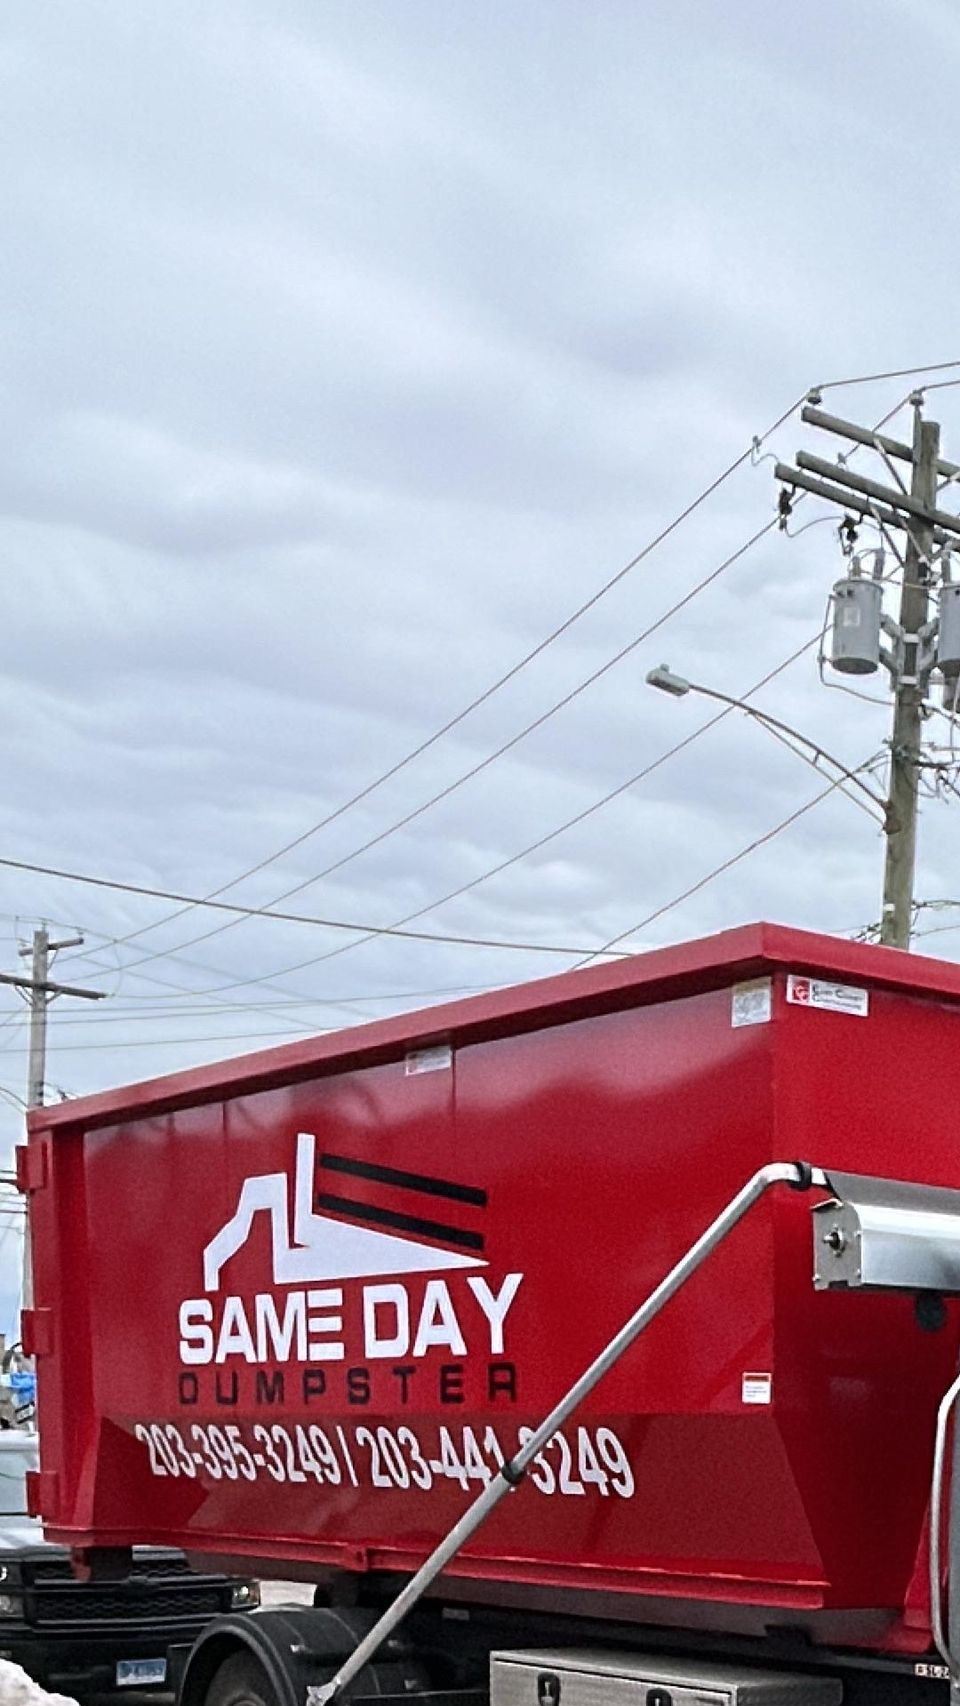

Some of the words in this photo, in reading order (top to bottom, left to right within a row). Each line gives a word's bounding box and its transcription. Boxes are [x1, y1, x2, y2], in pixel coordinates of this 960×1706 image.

[179, 1287, 345, 1365] SAME
[362, 1273, 524, 1359] DAY
[178, 1362, 517, 1406] DUMPSTER
[134, 1424, 341, 1485] 203-395-3249
